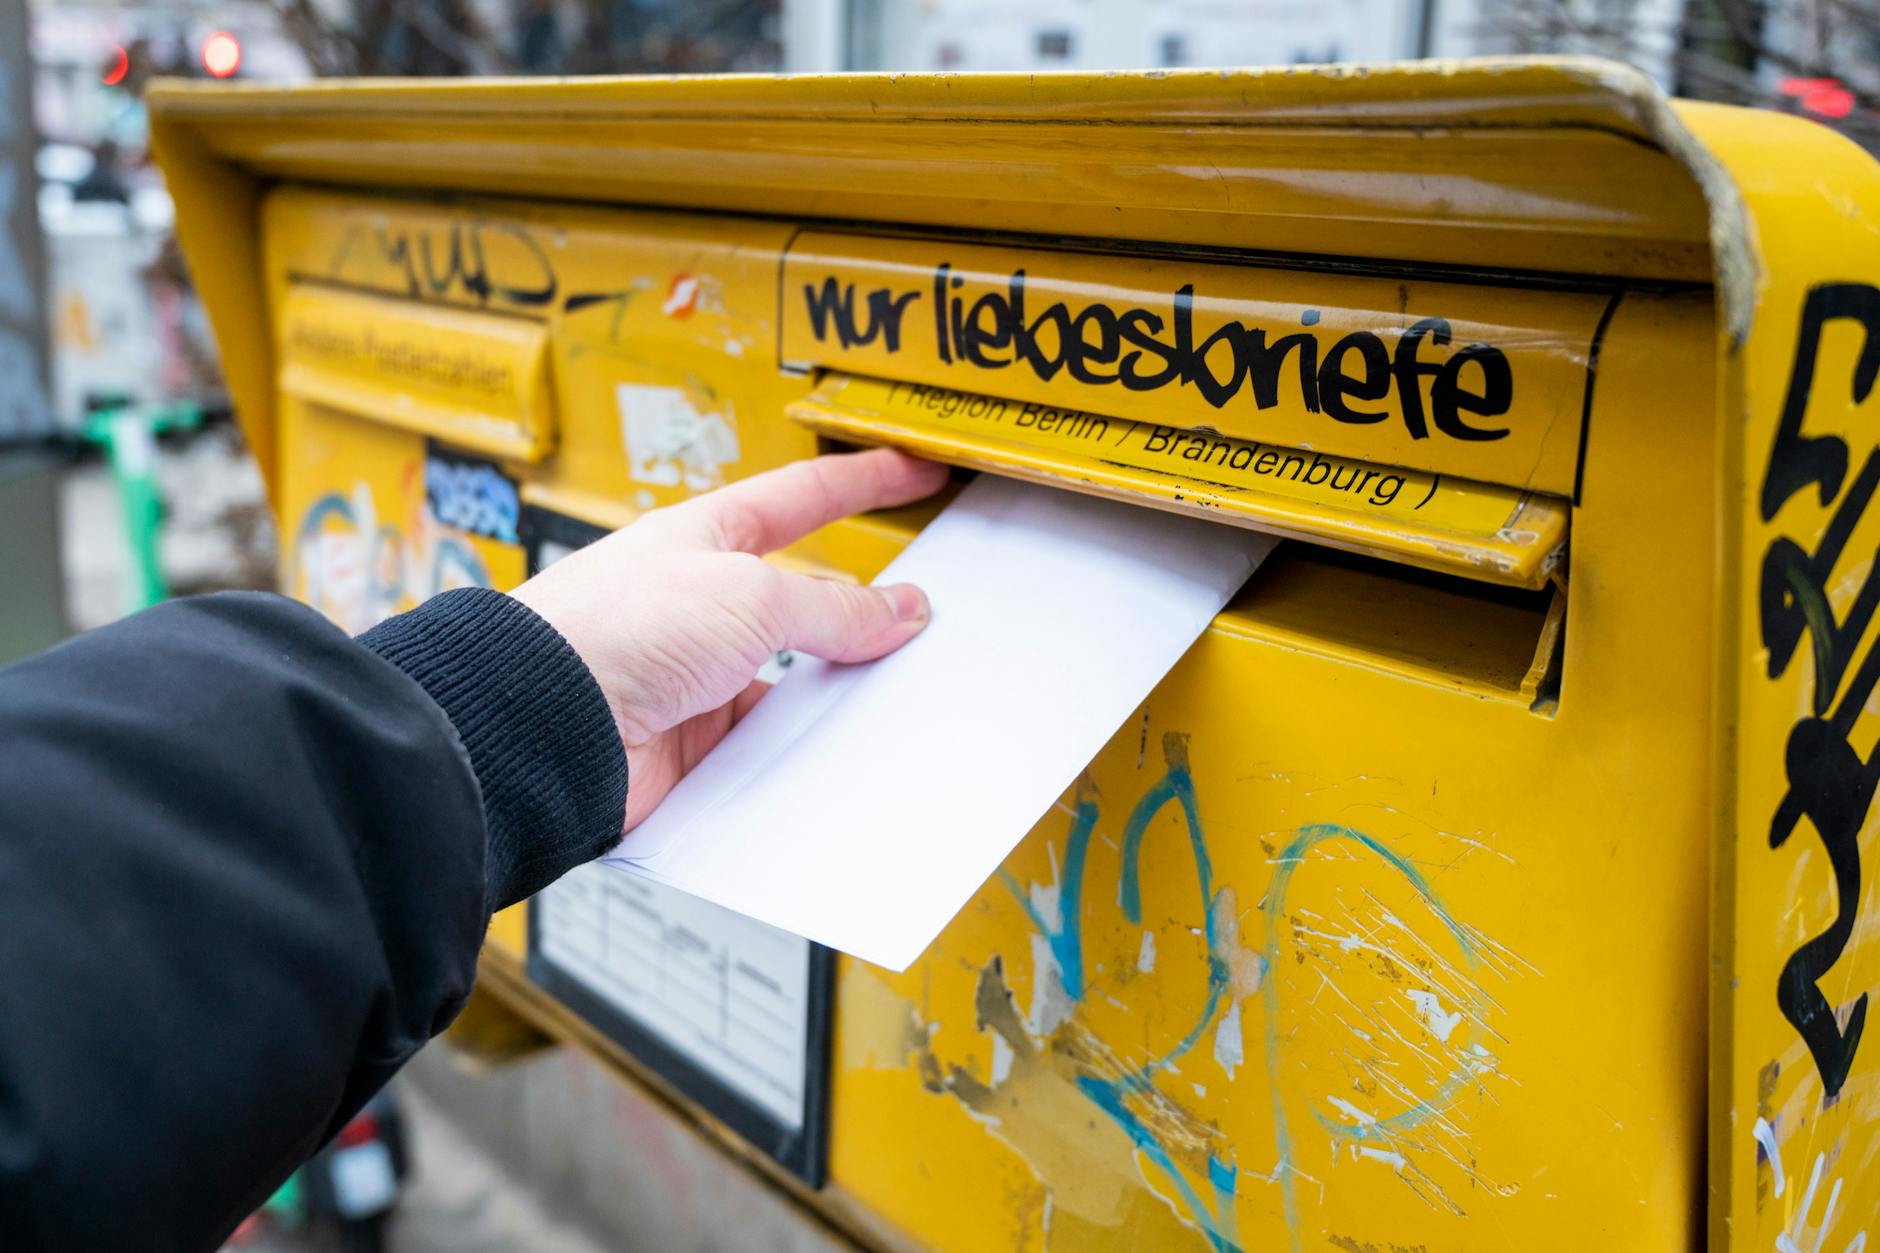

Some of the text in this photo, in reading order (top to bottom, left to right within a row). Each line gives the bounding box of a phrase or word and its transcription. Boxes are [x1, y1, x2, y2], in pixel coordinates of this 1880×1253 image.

[804, 263, 1513, 441] nur liebesbriefe
[906, 383, 1008, 419] Region
[1016, 402, 1109, 442] Berlin
[1144, 425, 1406, 506] Brandenburg
[1413, 473, 1440, 510] )
